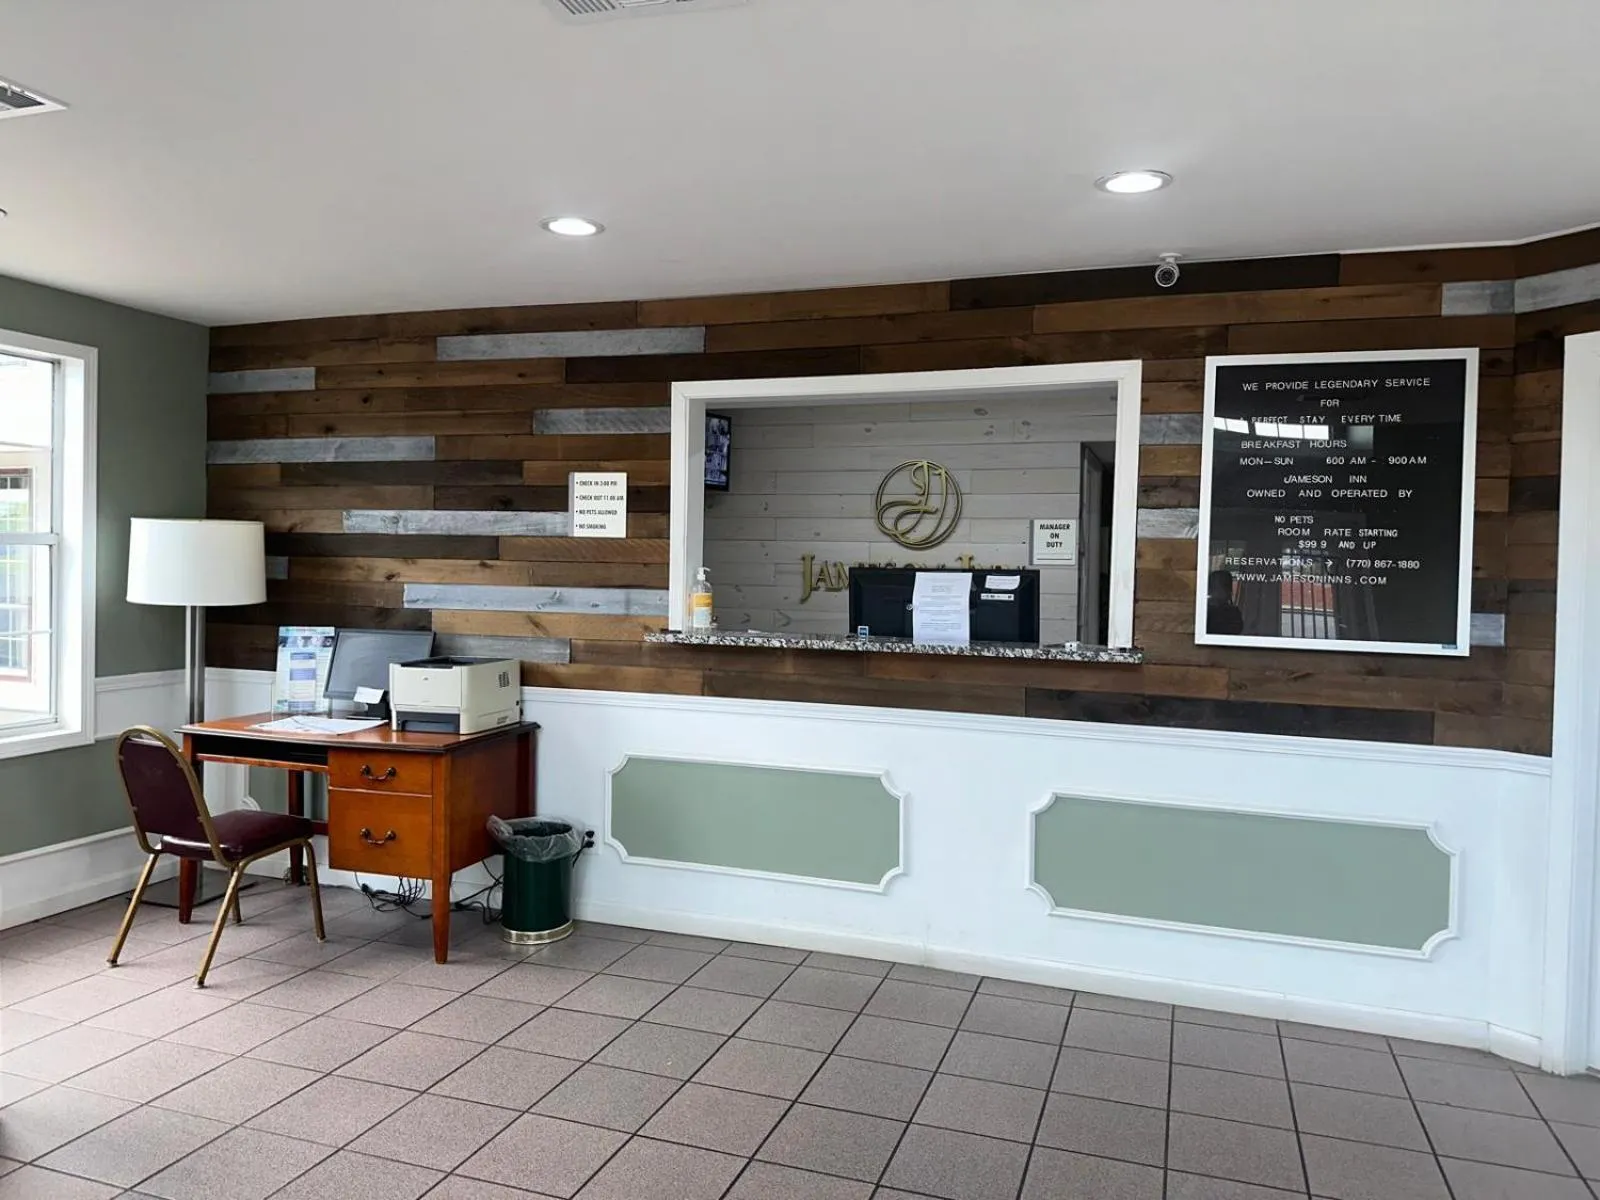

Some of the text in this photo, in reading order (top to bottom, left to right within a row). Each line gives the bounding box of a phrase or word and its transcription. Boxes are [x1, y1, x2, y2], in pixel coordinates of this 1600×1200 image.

[1242, 377, 1431, 391] WE PROVIDE LEGENDARY SERVICE
[1320, 399, 1340, 407] FOR
[1300, 415, 1326, 424] STAY
[1341, 414, 1375, 424] EVERY
[1378, 413, 1402, 423] TIME
[1241, 439, 1347, 449] BREAKFAST HOURS
[1326, 457, 1345, 465] 600
[1350, 456, 1367, 465] AM
[1284, 475, 1368, 484] JAMESON INN
[1246, 489, 1413, 498] OWNED AND OPERATED BY
[1290, 516, 1314, 524] PETS
[1277, 527, 1398, 537] ROOM RATE STARTING
[1338, 541, 1355, 549] AND
[1363, 541, 1377, 549] UP
[1225, 557, 1420, 569] RESERVATIONS (770) 867-1880
